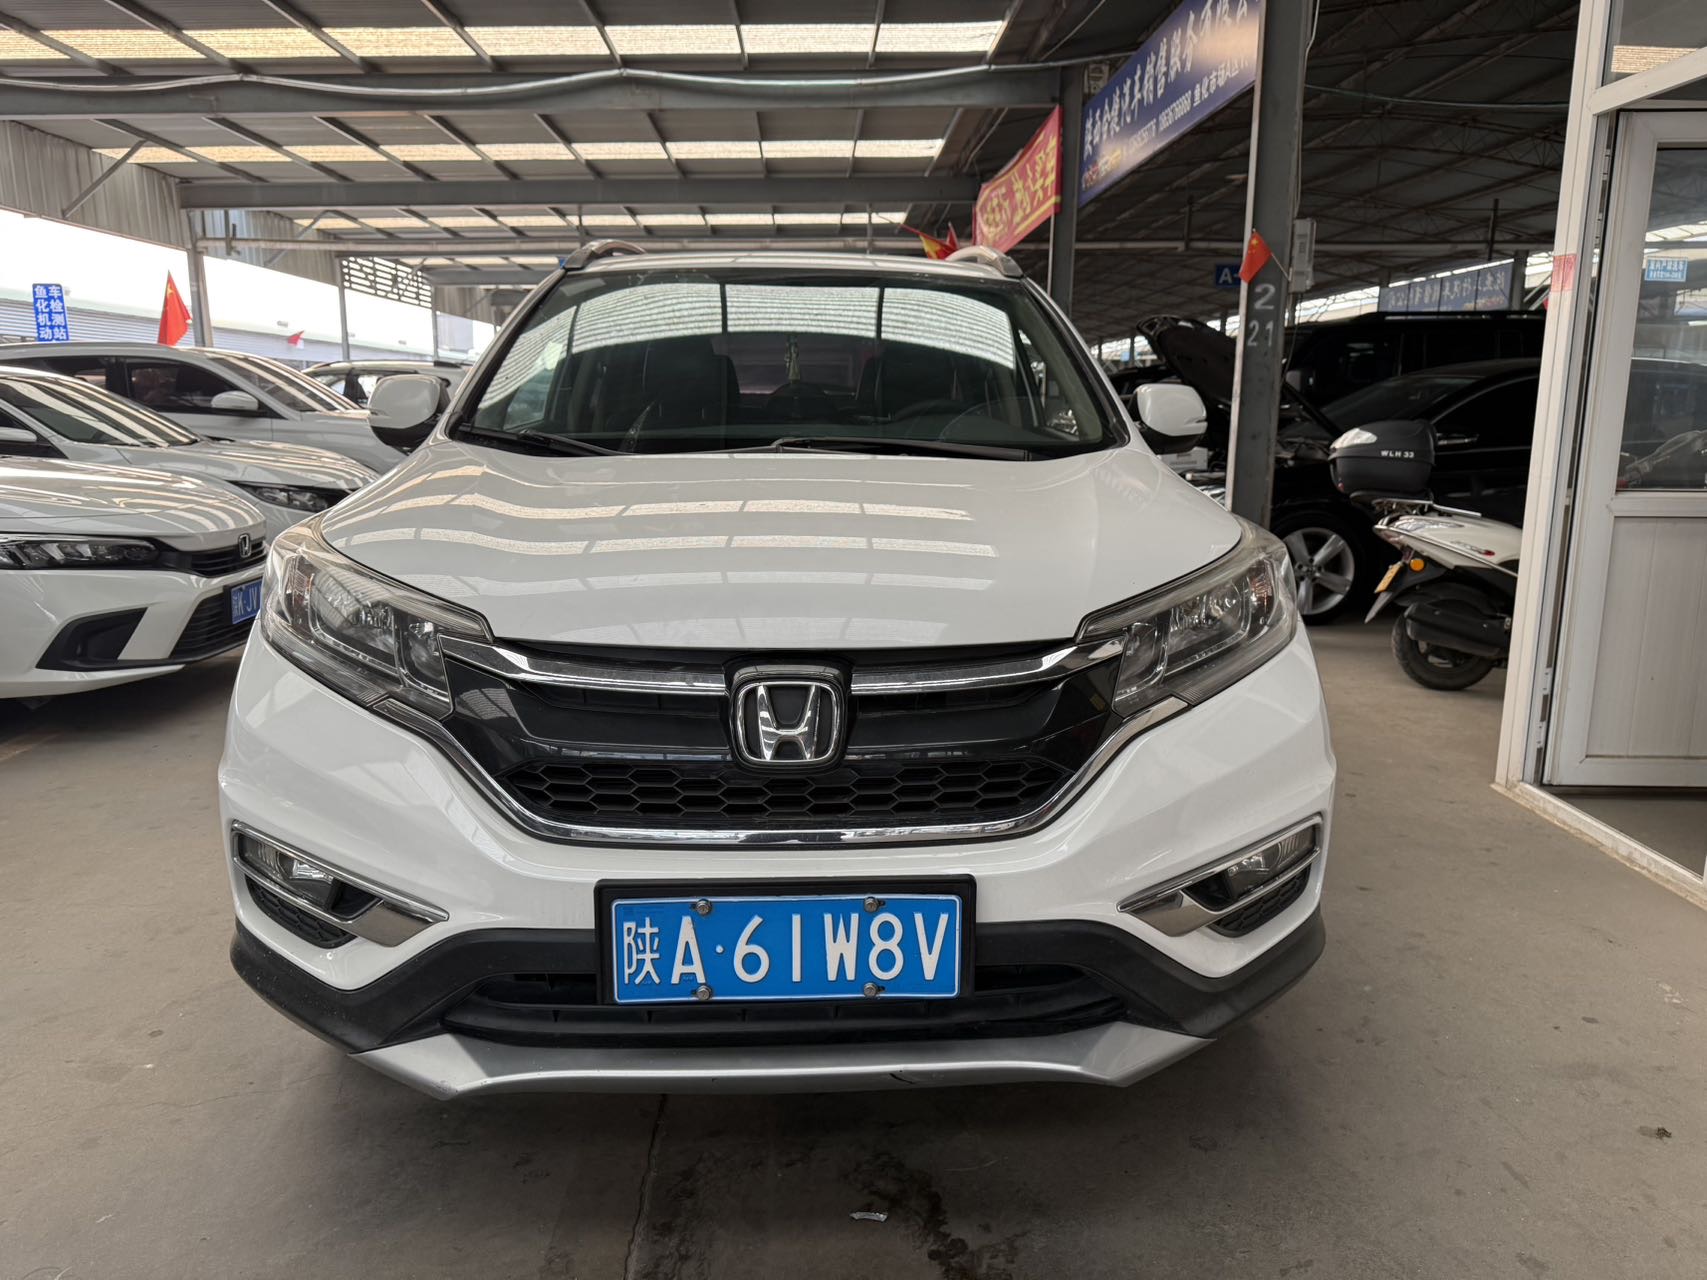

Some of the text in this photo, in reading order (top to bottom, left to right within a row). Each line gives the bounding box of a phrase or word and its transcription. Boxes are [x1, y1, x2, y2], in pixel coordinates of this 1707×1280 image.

[1218, 267, 1240, 284] A-
[1253, 283, 1276, 310] 2
[34, 285, 53, 340] 鱼化机动
[48, 285, 67, 340] 车检测站
[623, 912, 948, 985] 陕A·61W8V
